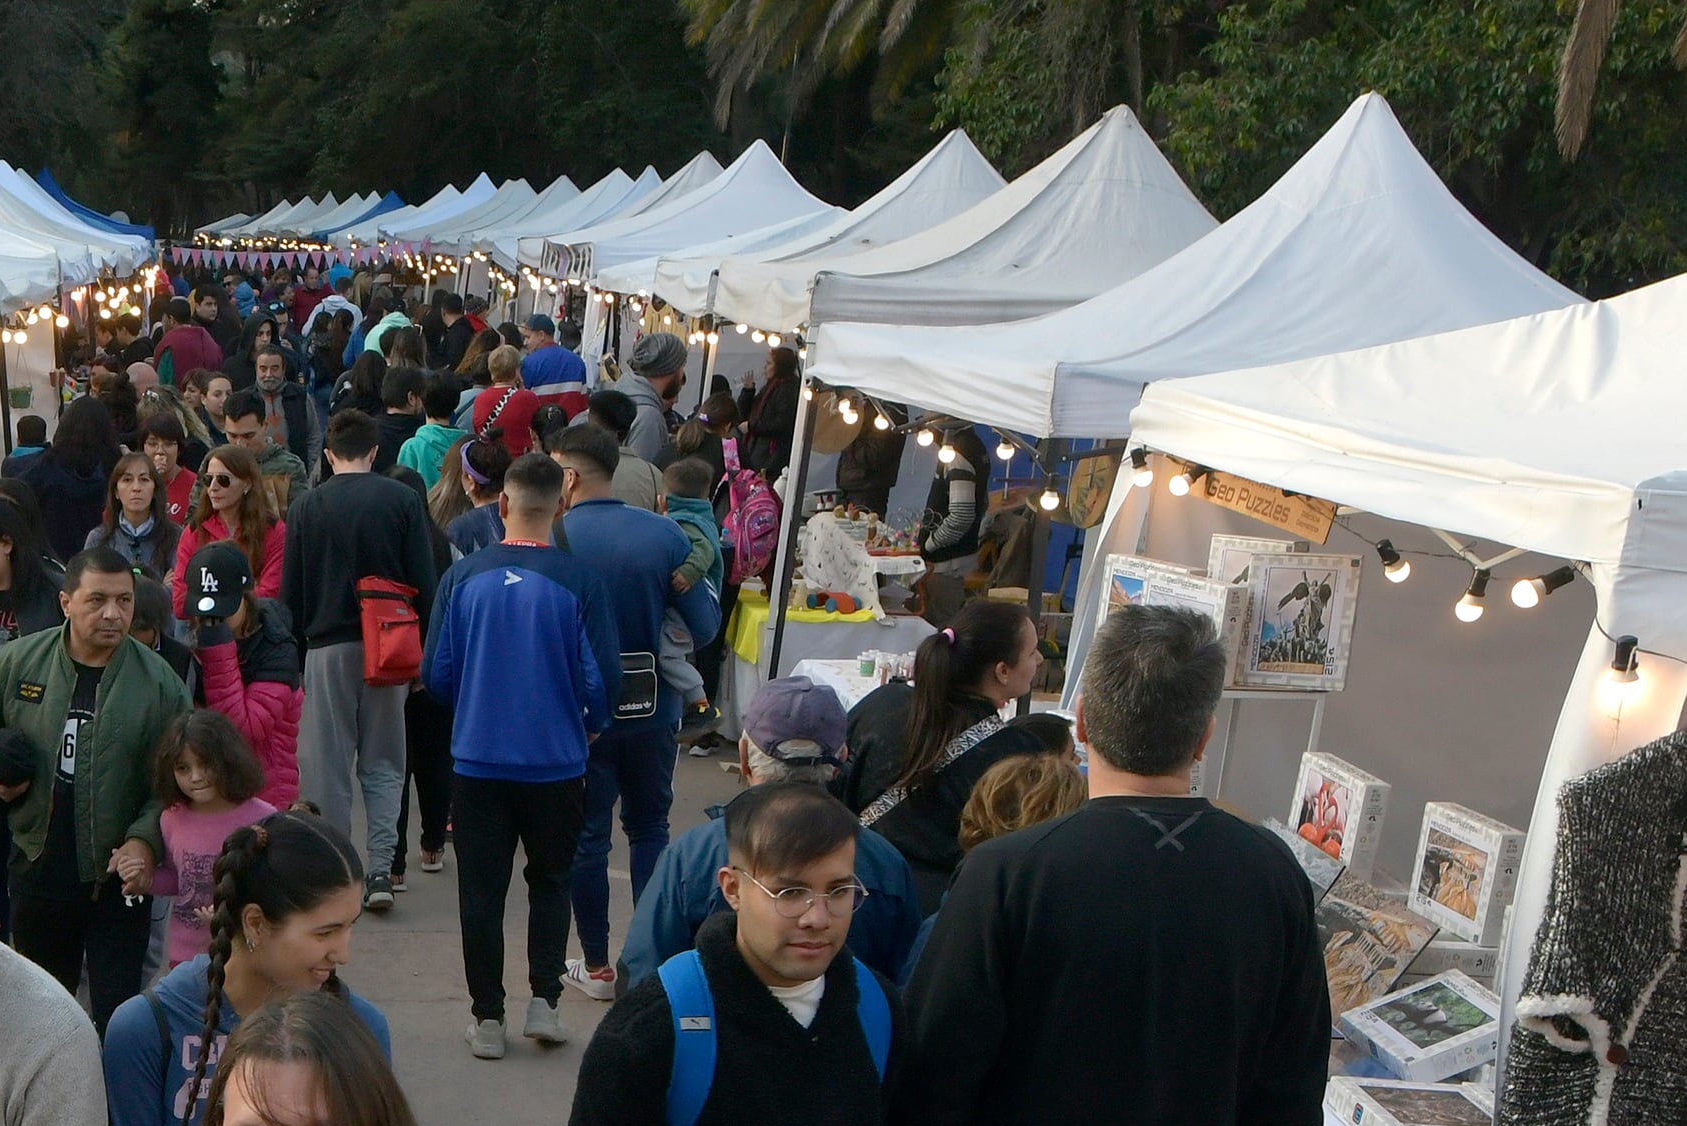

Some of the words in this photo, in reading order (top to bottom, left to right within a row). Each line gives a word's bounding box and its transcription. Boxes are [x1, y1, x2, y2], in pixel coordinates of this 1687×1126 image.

[1206, 478, 1236, 504] Geo
[1235, 487, 1292, 525] Puzzles
[200, 567, 219, 593] LA
[63, 733, 75, 759] 6
